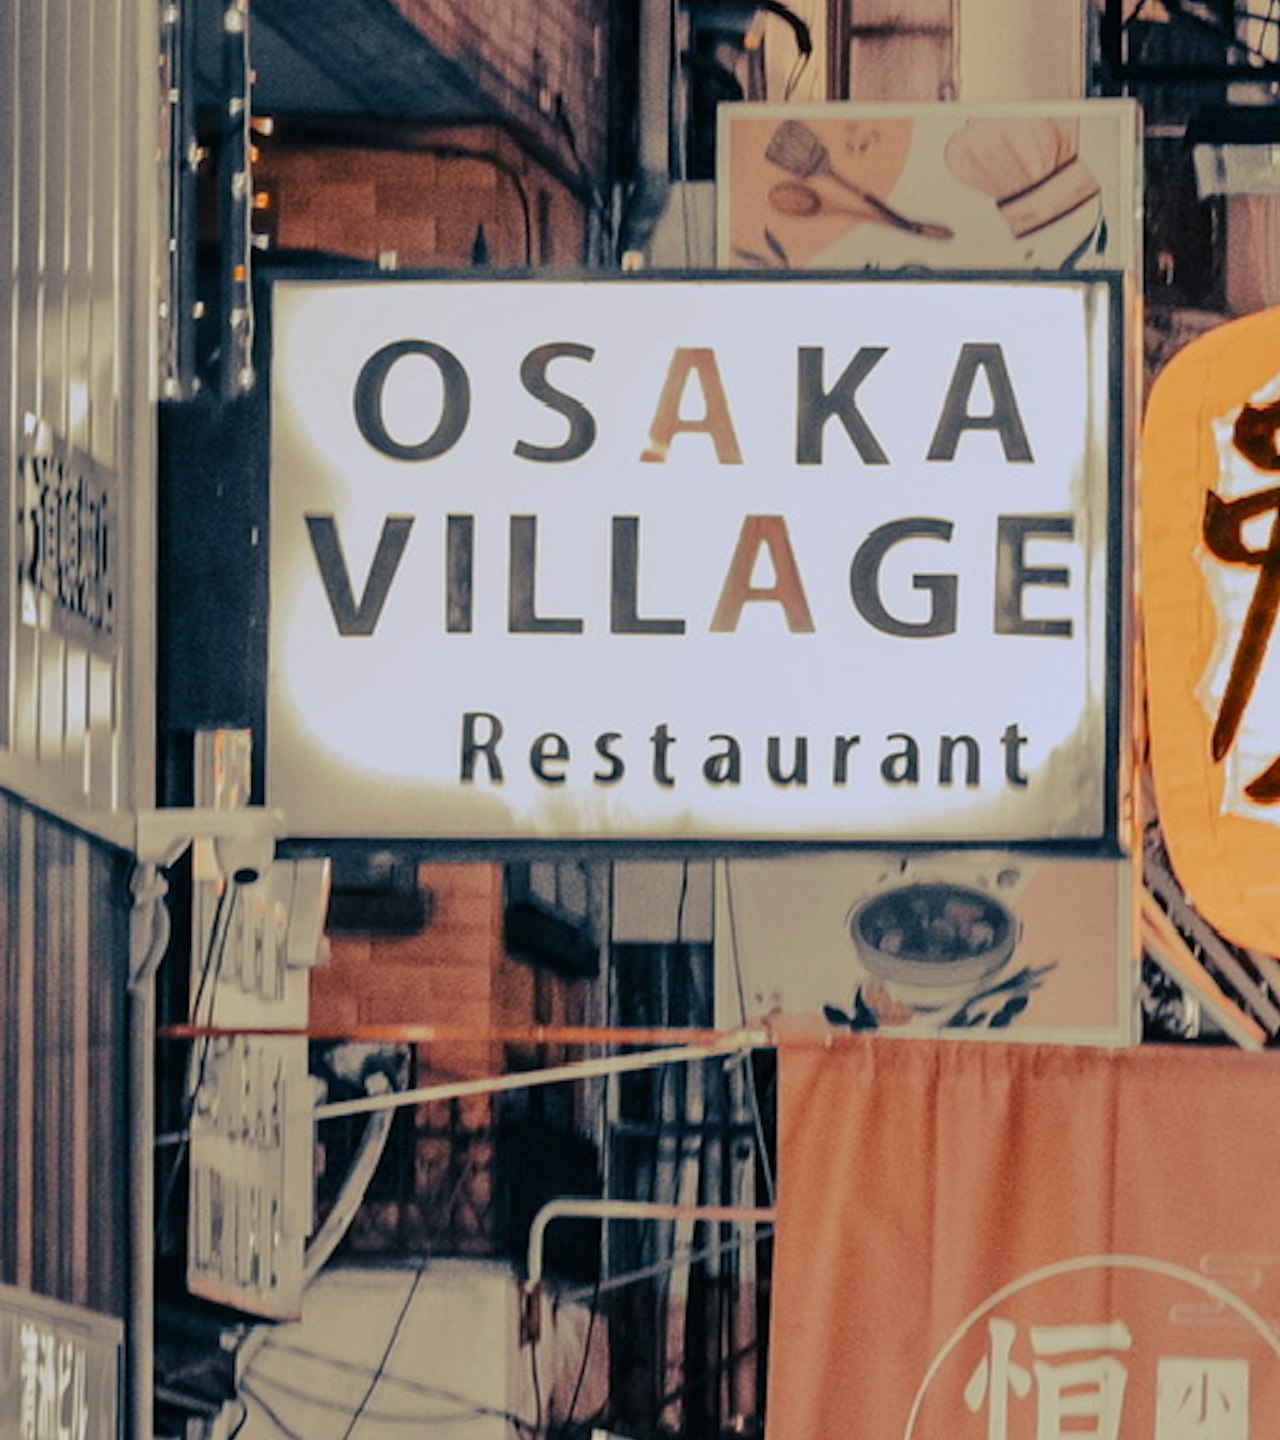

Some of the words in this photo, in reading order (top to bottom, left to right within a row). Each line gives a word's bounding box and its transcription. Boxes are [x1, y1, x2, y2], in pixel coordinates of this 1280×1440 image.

[352, 338, 1035, 465] OSAKA
[303, 513, 1075, 638] VILLAGE
[460, 710, 1030, 788] Restaurant
